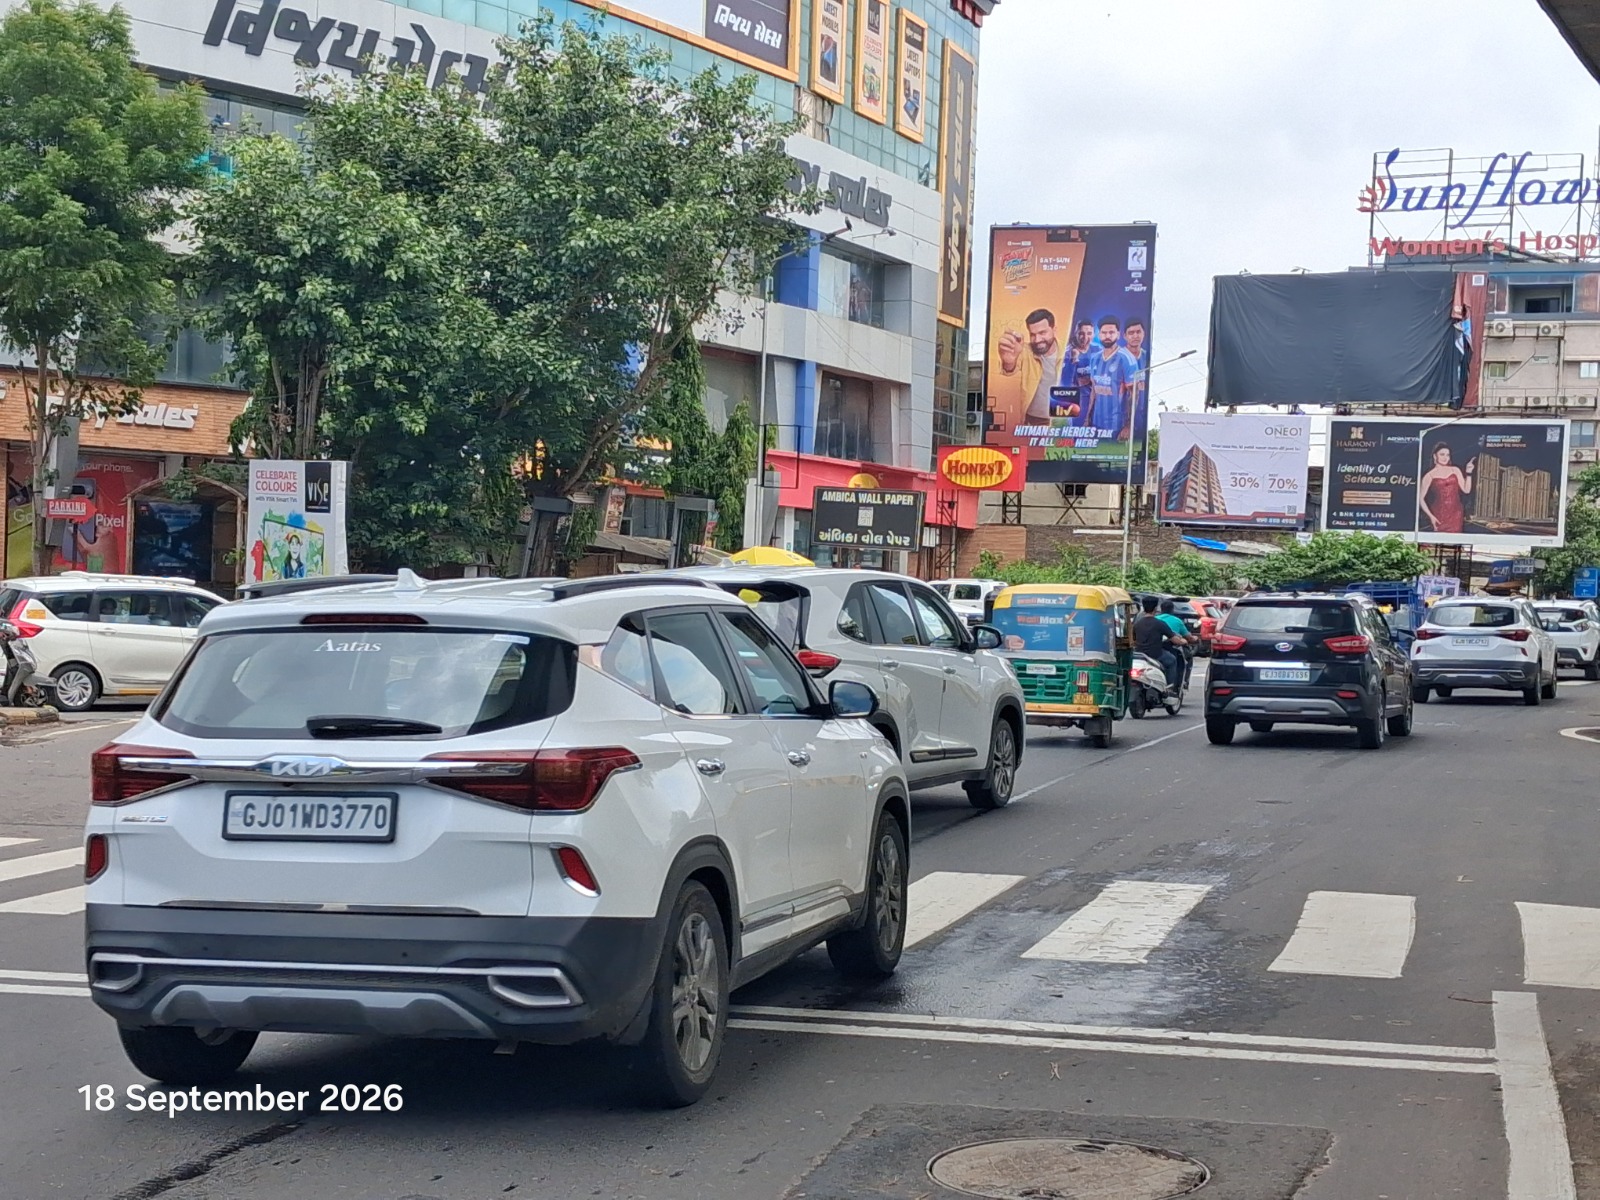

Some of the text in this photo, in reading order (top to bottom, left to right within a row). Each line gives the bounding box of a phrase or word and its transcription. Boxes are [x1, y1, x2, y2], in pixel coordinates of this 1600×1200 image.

[1381, 147, 1600, 229] Sunflow
[1369, 230, 1505, 257] Women's
[1014, 424, 1049, 437] HITMAN
[1061, 425, 1097, 438] HEROES
[1097, 428, 1114, 438] TAK
[1029, 437, 1038, 447] IT
[1039, 437, 1055, 447] ALL
[1074, 438, 1099, 448] HERE
[1336, 440, 1377, 448] HARMONY
[947, 459, 1006, 476] HONEST
[1337, 463, 1392, 475] Identity Of
[255, 470, 297, 480] CELEBRATE
[1344, 474, 1387, 484] Science
[255, 480, 298, 493] COLOURS
[1230, 476, 1299, 490] 30% 70%
[822, 491, 914, 506] AMBICA WALL PAPER
[95, 513, 125, 528] Pixel
[312, 637, 382, 653] Aatas
[242, 802, 386, 829] GJ01WD3770
